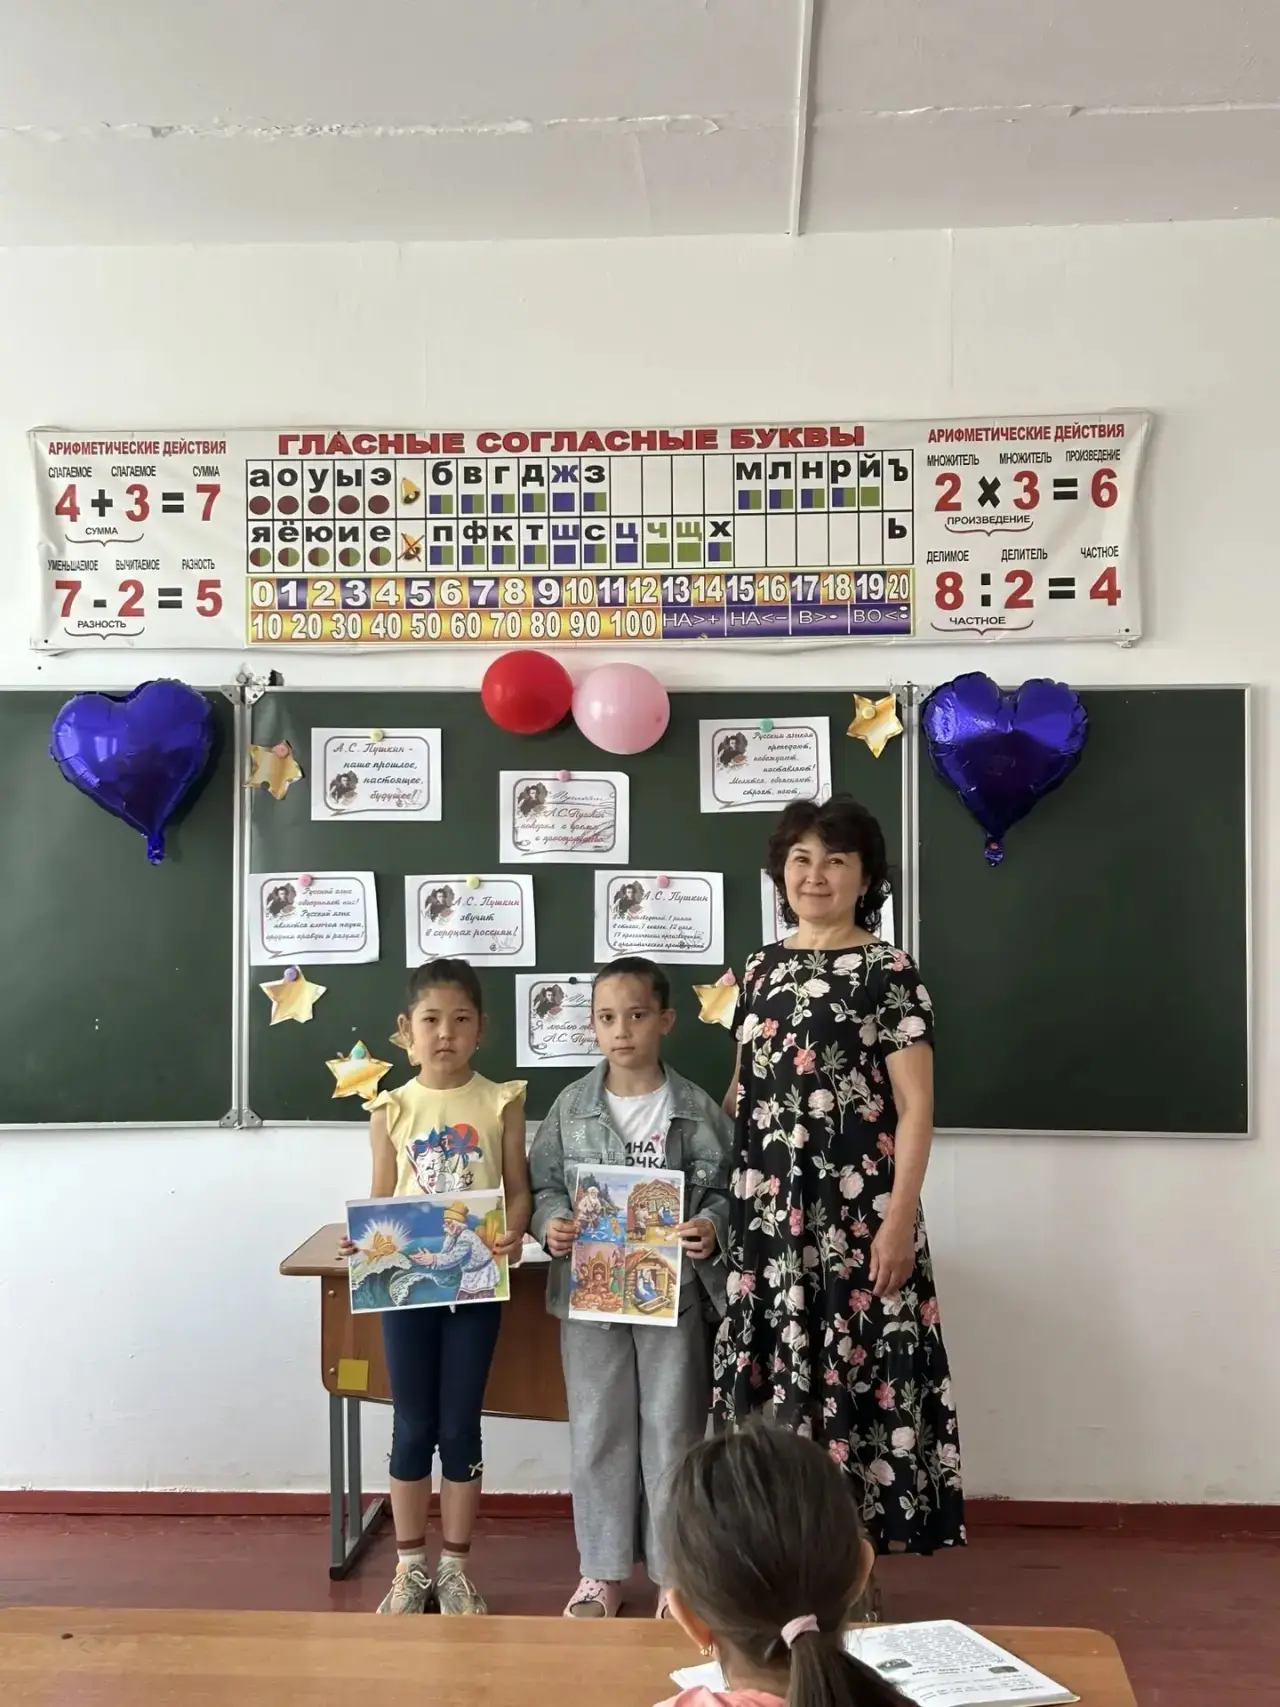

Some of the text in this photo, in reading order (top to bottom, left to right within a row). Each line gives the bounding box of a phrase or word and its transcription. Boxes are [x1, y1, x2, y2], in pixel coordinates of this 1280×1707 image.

[928, 422, 1124, 443] АРИФМЕТИЧЕСКИЕ ДЕЙСТВИЯ
[49, 438, 226, 456] АРИФМЕТИЧЕСКИЕ ДЕЙСТВИЯ
[278, 426, 865, 455] ГЛАСНЫЕ СОГЛАСНЫЕ БУКВЫ
[928, 449, 1120, 466] МНОЖИТЕЛЬ МНОЖИТЕЛЬ ПРОИЗВЕДЕНИЕ
[49, 466, 220, 478] СЛАГАЕМОЕ СЛАГАЕМОЕ СУММА
[935, 472, 962, 512] 2
[1013, 470, 1040, 510] 3
[1053, 478, 1078, 500] =
[1091, 468, 1118, 508] 6
[55, 484, 221, 522] 4 + 3 = 7
[947, 515, 1030, 525] ПРОИЗВЕДЕНИЕ
[85, 527, 118, 535] СУММА
[927, 546, 1119, 564] ДЕЛИМОЕ ДЕЛИТЕЛЬ ЧАСТНОЕ
[48, 559, 215, 571] УМЕНЬШАЕМОЕ ВЫЧИТАЕМОЕ РАЗНОСТЬ
[252, 574, 909, 606] 0 1 2 3 4 5 6 7 8 9 10 11 12 13 14 15 16 17 18 19 20
[935, 566, 1121, 610] 8 : 2 = 4
[55, 580, 82, 617] 7
[118, 580, 144, 616] 2
[158, 588, 182, 608] =
[196, 580, 223, 617] 5
[252, 610, 656, 640] 10 20 30 40 50 60 70 80 90 100
[950, 617, 1006, 625] ЧАСТНОЕ
[363, 743, 404, 755] Пушкин
[373, 761, 417, 770] прошлое,
[480, 897, 520, 908] Пушкин
[669, 892, 708, 903] Пушкин
[460, 913, 494, 923] звучит
[434, 930, 471, 938] сердцах
